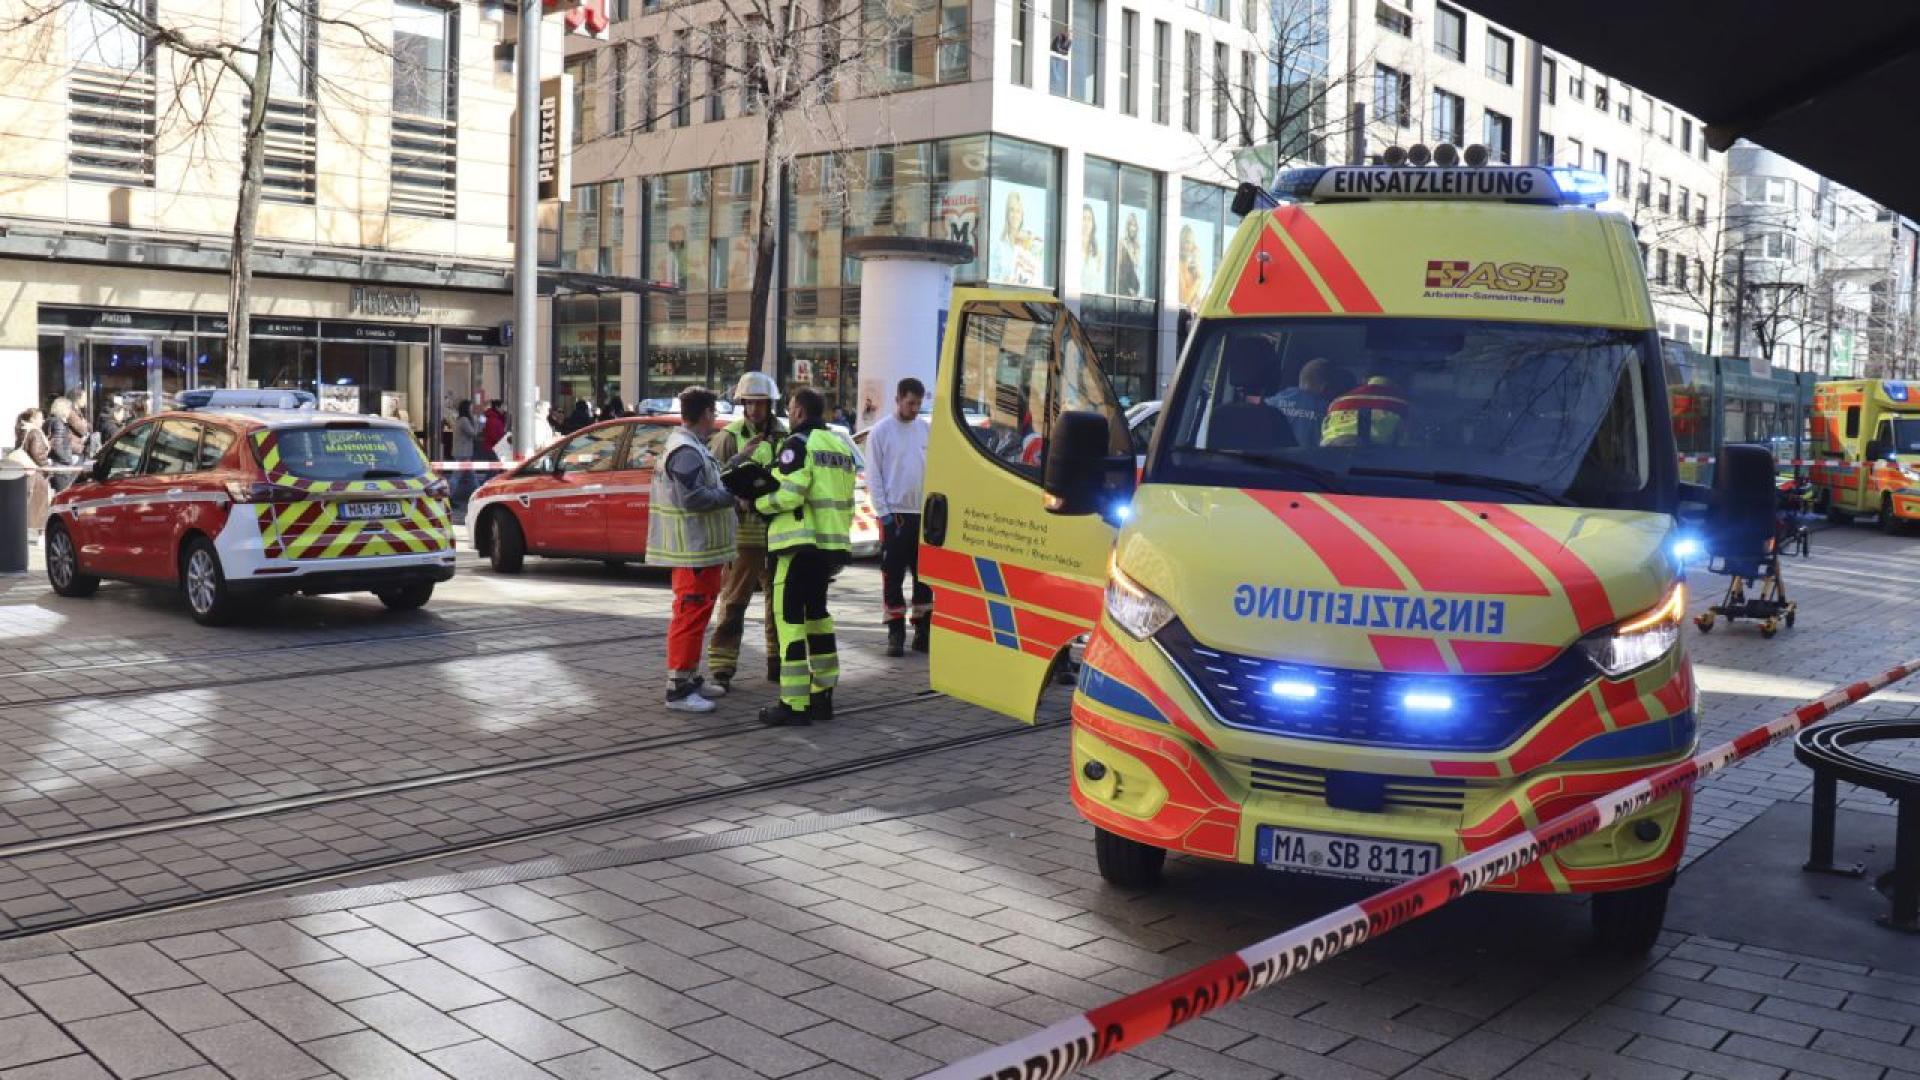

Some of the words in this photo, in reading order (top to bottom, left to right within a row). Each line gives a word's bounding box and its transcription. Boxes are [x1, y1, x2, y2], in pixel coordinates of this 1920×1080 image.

[1334, 171, 1535, 194] EINSATZLEITUNG
[1457, 261, 1569, 294] ASB
[1422, 290, 1565, 305] Arbeiter-Samariter-Bund
[348, 503, 363, 516] MA
[1274, 834, 1306, 863] MA
[1327, 841, 1359, 869] SB
[1367, 845, 1431, 876] 8111
